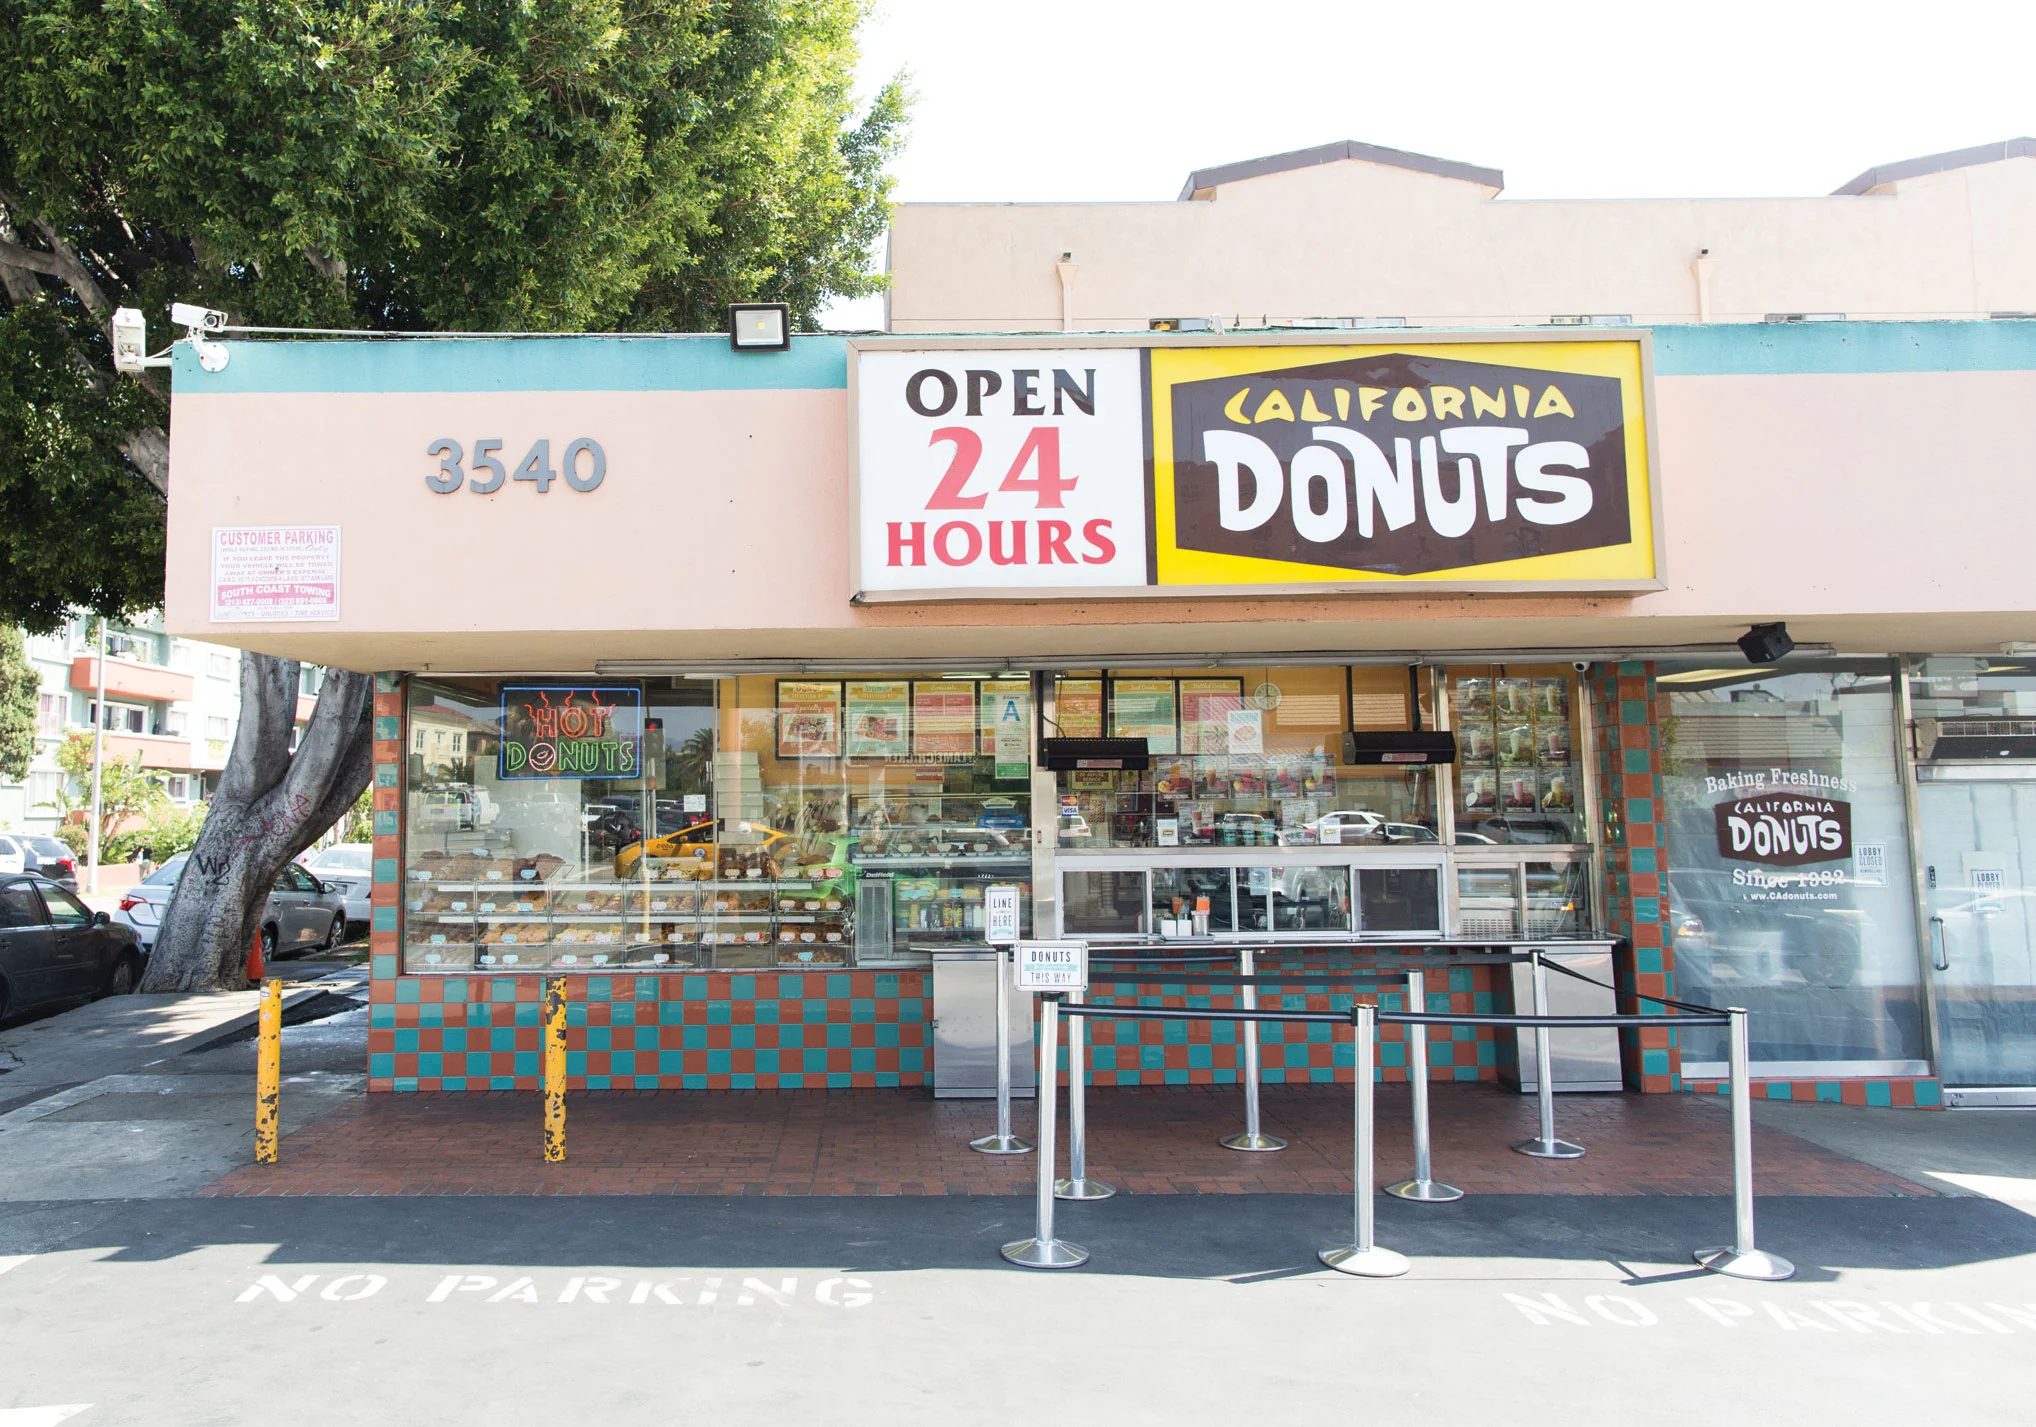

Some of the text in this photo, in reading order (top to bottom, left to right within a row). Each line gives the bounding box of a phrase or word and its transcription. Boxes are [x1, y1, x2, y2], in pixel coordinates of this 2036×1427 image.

[905, 368, 1096, 417] OPEN
[1224, 384, 1575, 425] CALIFORNIA
[425, 437, 607, 494] 3540
[924, 426, 1080, 510] 24
[1203, 426, 1594, 543] DONUTS
[220, 531, 333, 545] CUSTOMER PARKING
[886, 518, 1117, 567] HOURS
[221, 584, 331, 600] SOUTH COAST TOWING
[535, 708, 607, 738] HOT
[1002, 700, 1021, 722] A
[506, 742, 634, 772] DONUTS
[1704, 768, 1858, 794] Baking Freshness
[1734, 801, 1835, 814] CALIFORNIA
[1727, 815, 1842, 857] DONUTS
[1858, 848, 1882, 856] LOBBY
[1860, 856, 1882, 866] CLOSED
[1732, 868, 1845, 888] Since 1982
[1976, 873, 1999, 882] LOBBY
[994, 898, 1012, 908] LINE
[993, 916, 1012, 926] HERE
[1032, 952, 1071, 962] DONUTS
[1031, 972, 1071, 983] THIS WAY
[234, 1274, 874, 1307] NO PARKING
[1501, 1292, 1659, 1328] NO
